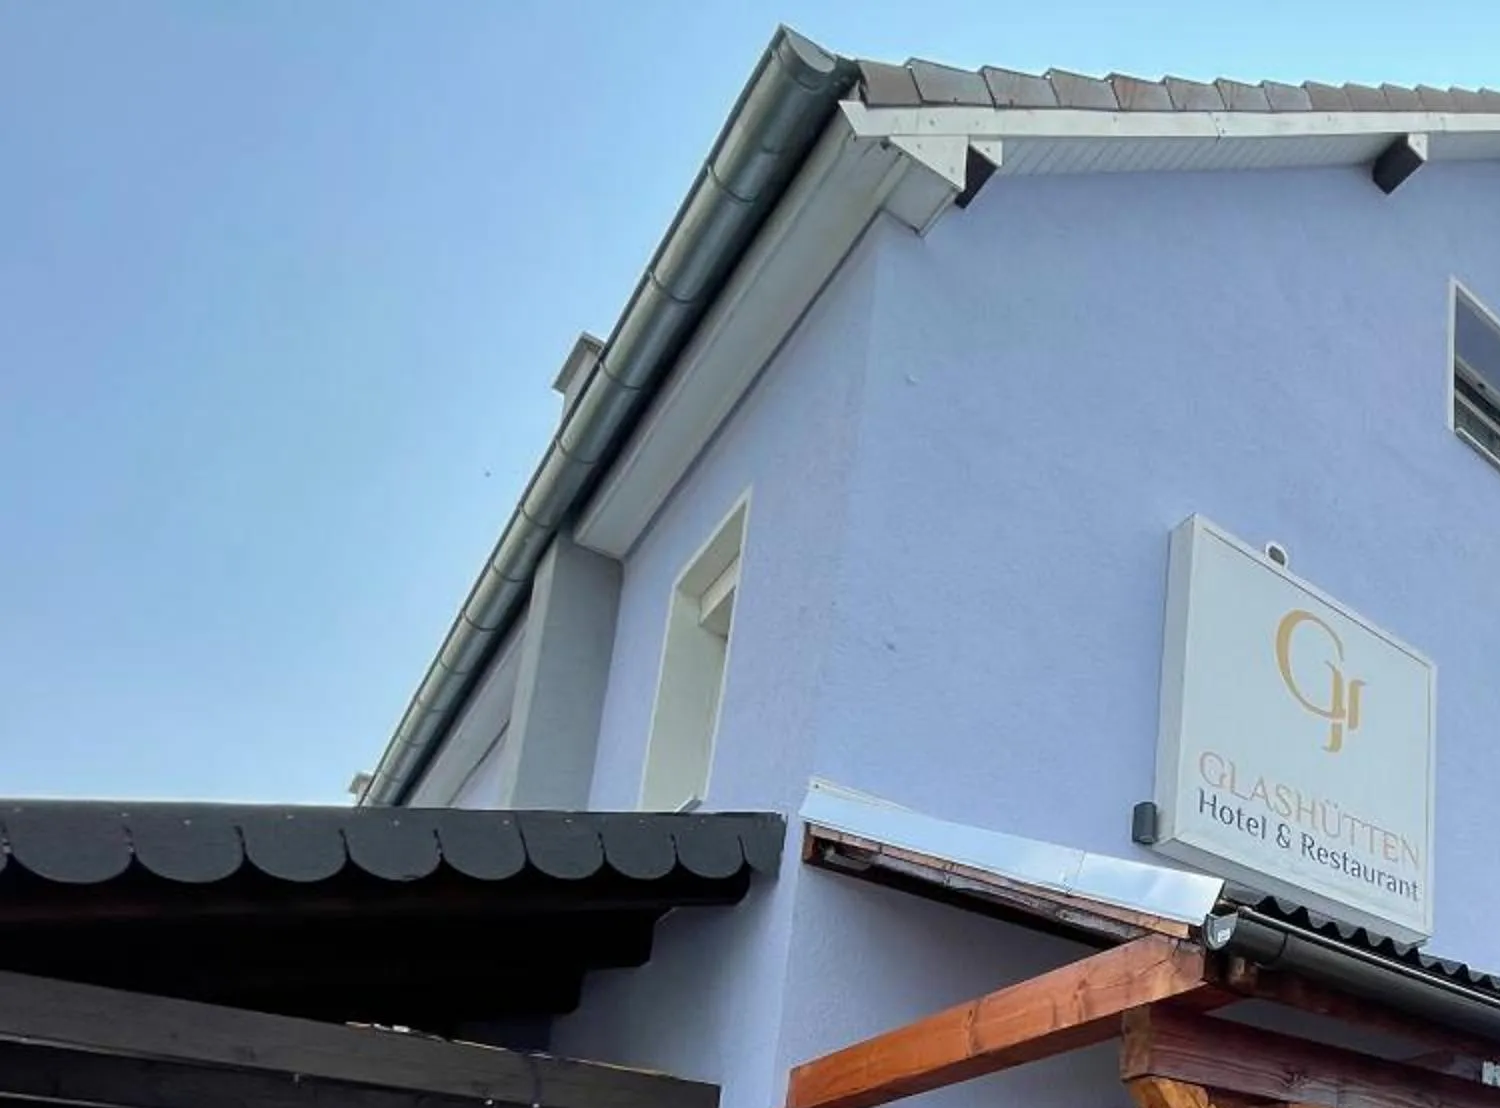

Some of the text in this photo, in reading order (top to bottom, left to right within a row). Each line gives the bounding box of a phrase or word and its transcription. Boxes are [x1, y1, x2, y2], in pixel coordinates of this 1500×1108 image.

[1199, 750, 1421, 872] GLASHÜTTEN
[1199, 789, 1422, 903] Hotel & Restaurant
